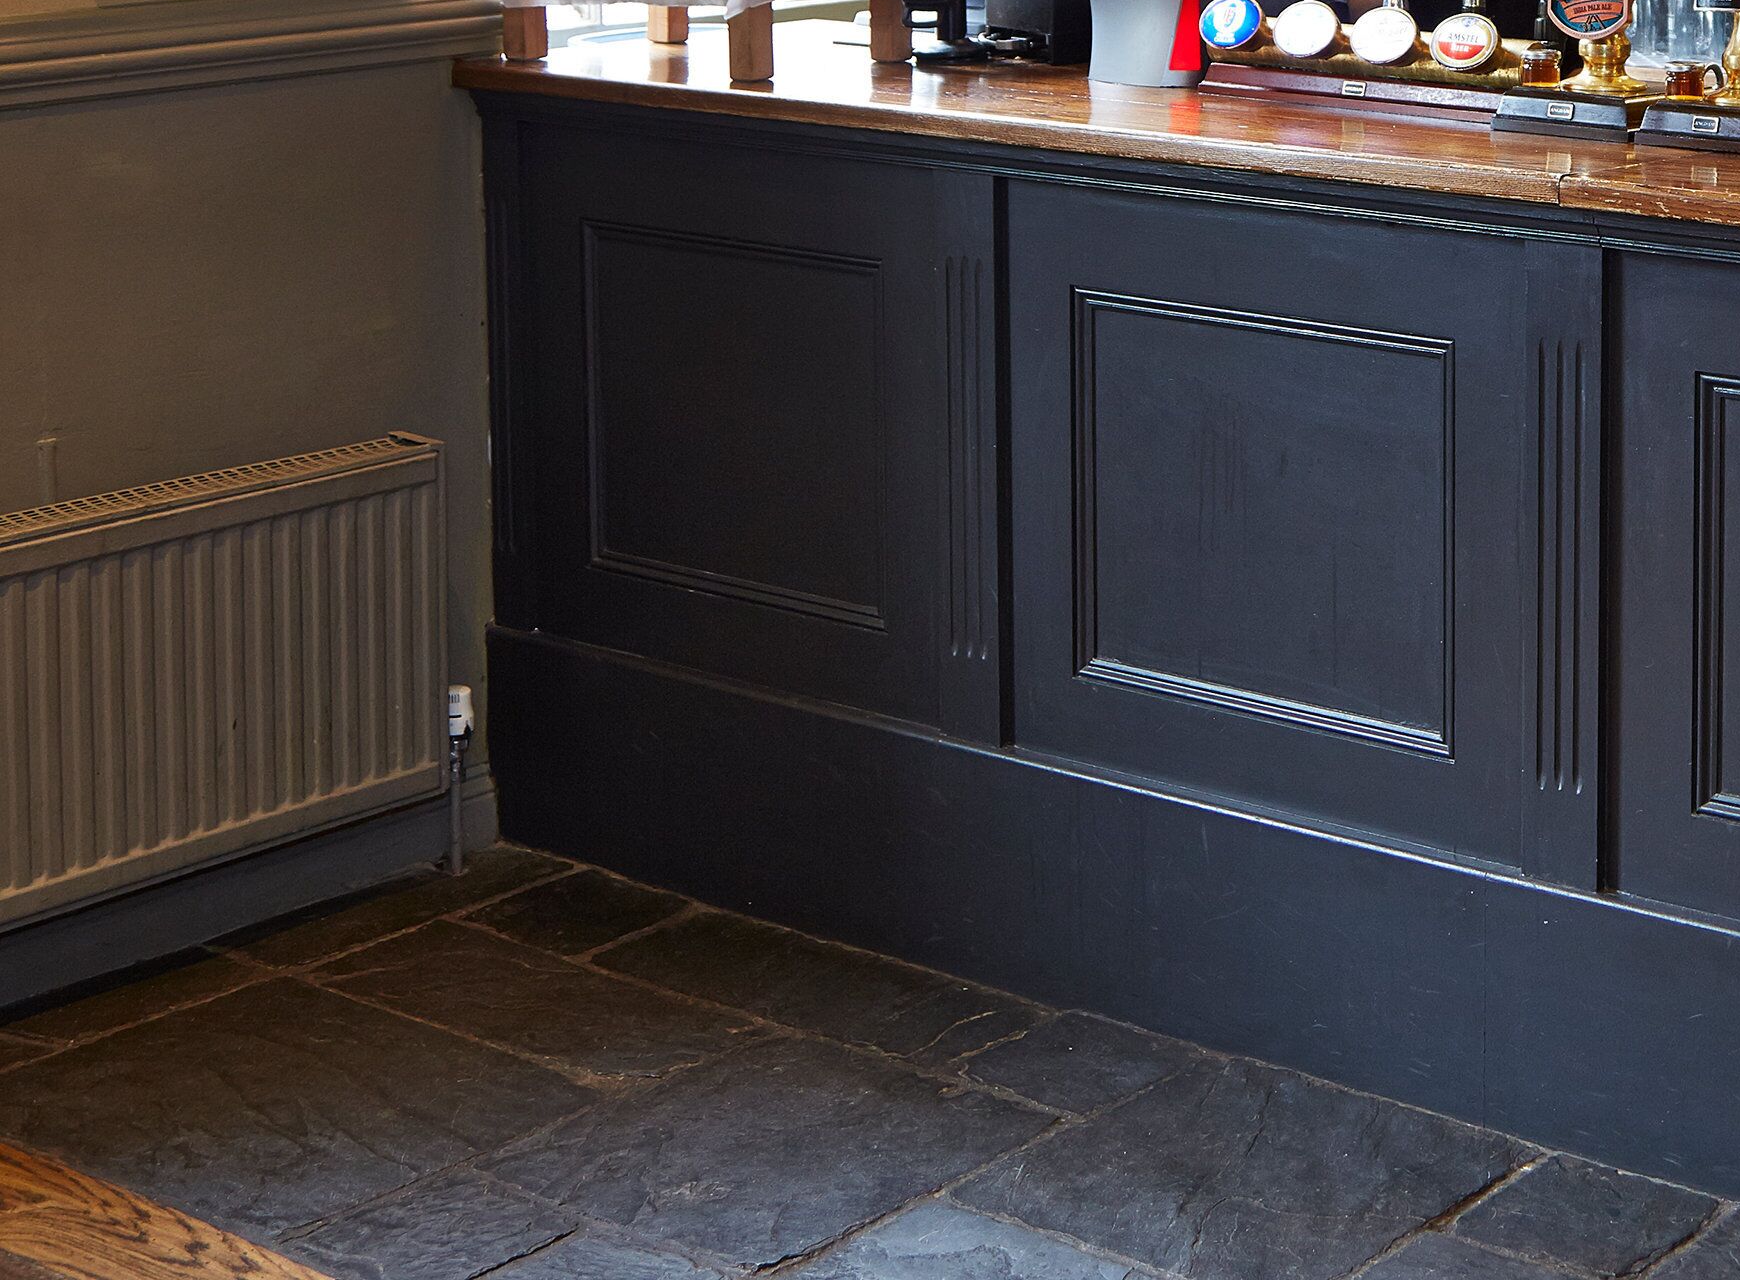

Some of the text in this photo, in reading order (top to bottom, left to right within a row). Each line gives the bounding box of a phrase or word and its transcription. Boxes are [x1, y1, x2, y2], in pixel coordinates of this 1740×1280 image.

[1588, 4, 1600, 12] PALE
[1602, 3, 1612, 11] ALE
[1449, 33, 1479, 43] AMSTEL
